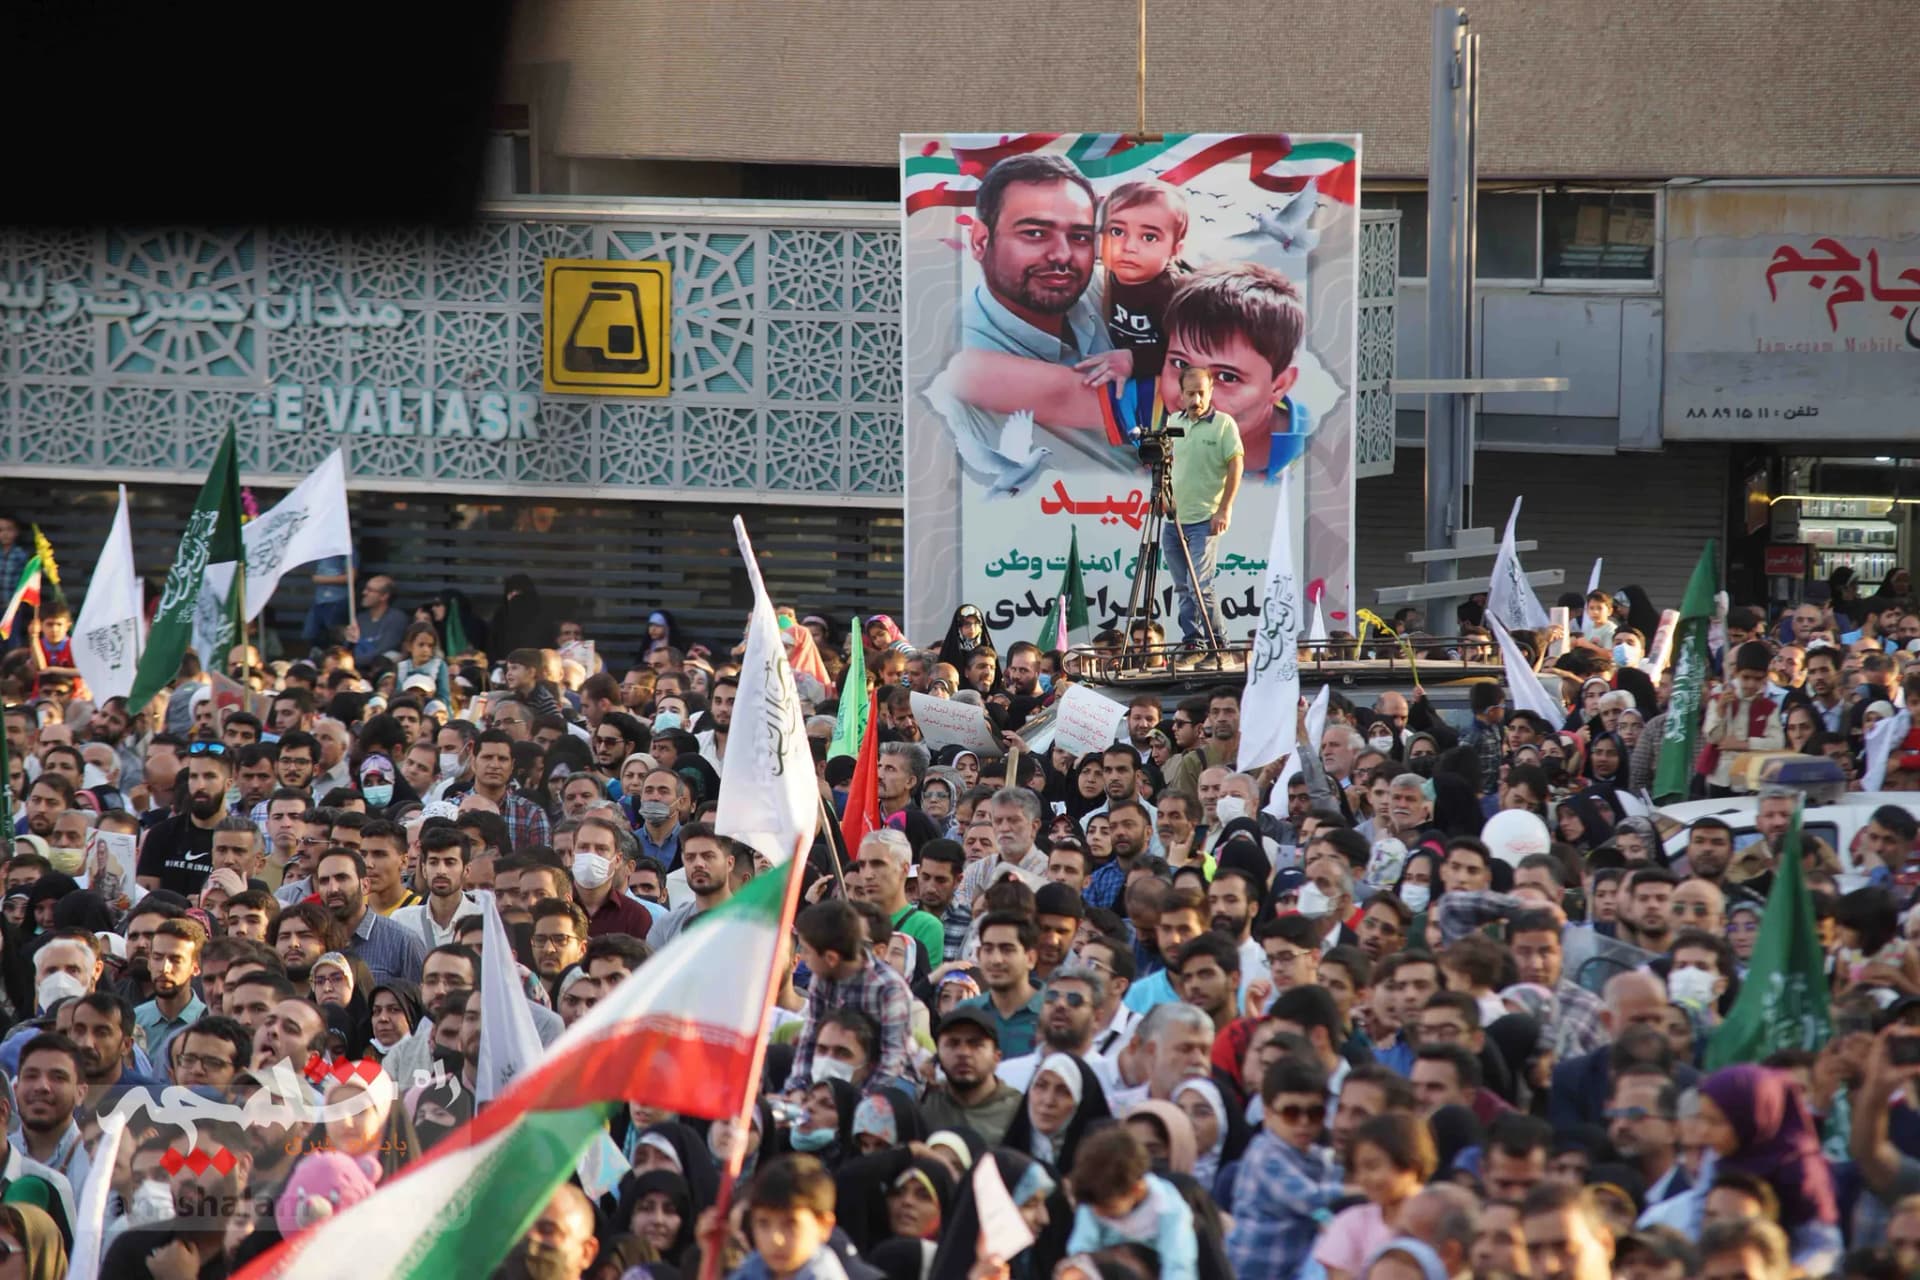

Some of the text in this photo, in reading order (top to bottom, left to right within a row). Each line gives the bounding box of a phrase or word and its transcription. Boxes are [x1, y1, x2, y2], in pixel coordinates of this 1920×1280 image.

[84, 274, 247, 334] حضرت
[321, 386, 543, 440] VALIASR
[1041, 480, 1160, 531] هید
[985, 549, 1043, 580] وطن
